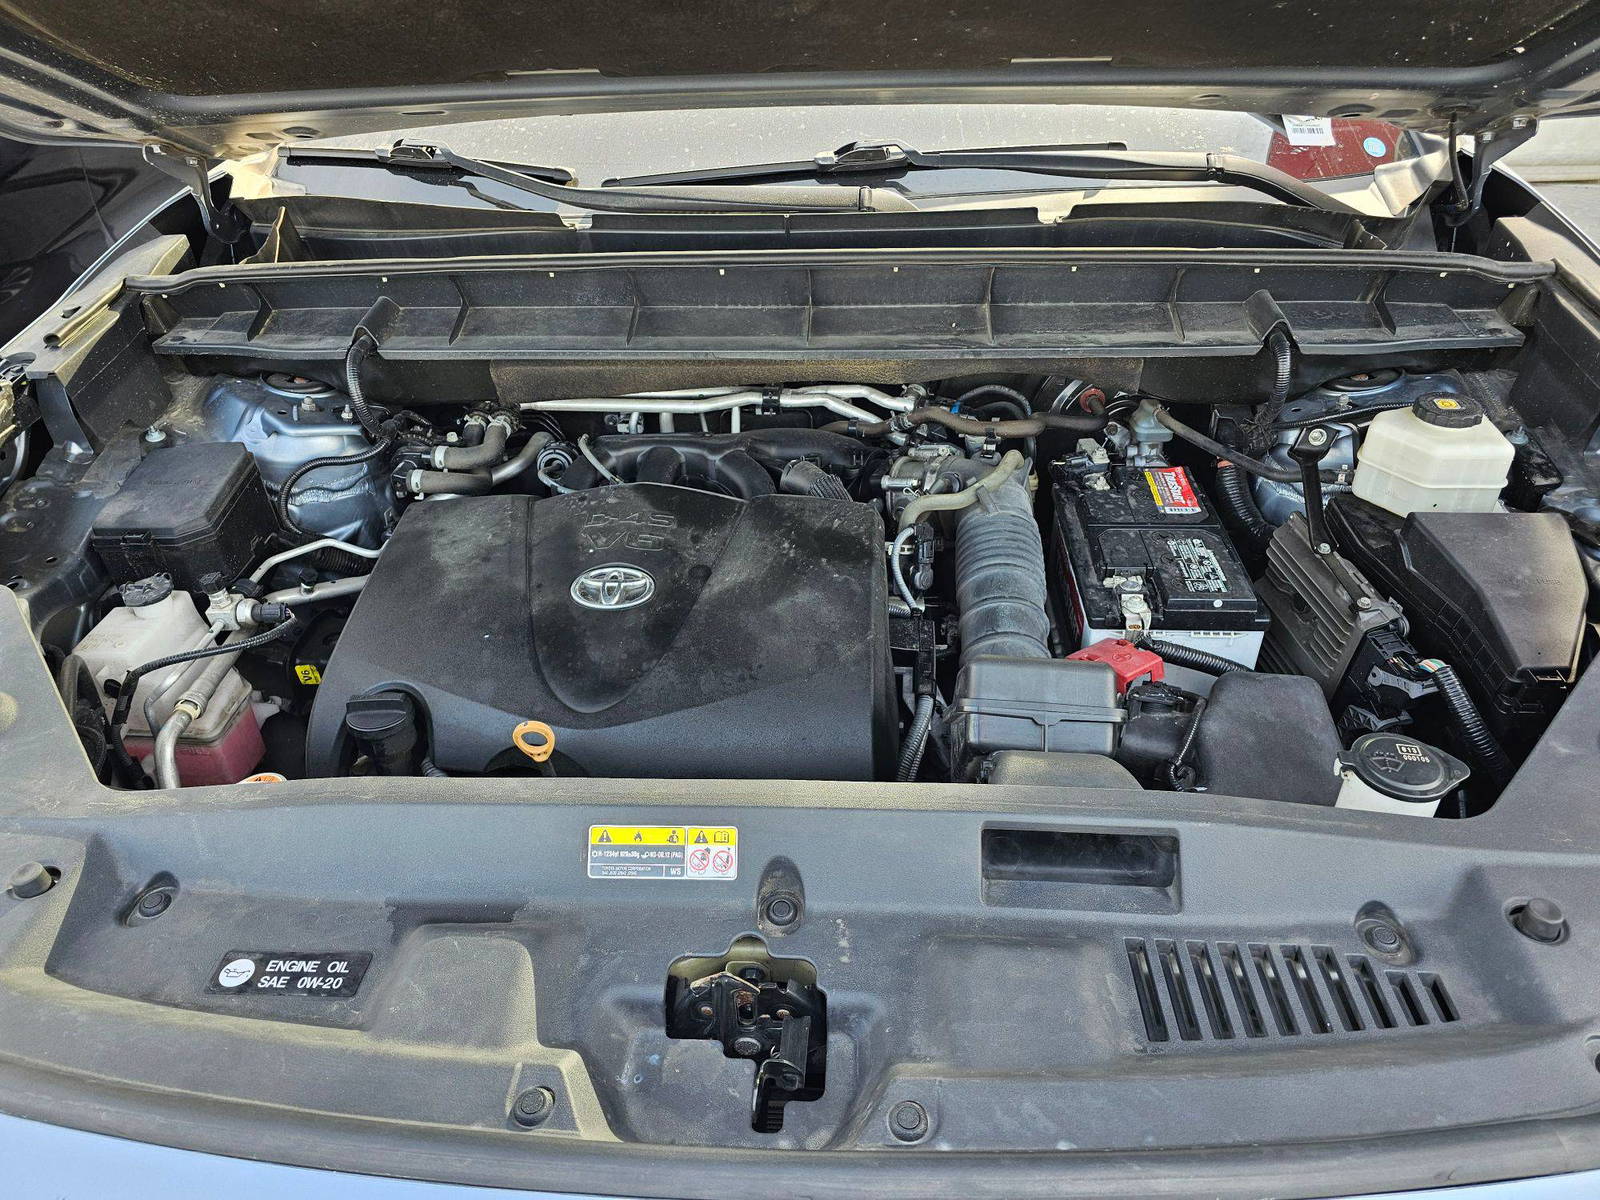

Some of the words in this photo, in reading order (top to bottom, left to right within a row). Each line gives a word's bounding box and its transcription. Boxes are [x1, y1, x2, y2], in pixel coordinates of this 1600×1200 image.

[265, 960, 320, 973] ENGINE
[327, 961, 349, 973] OIL
[257, 976, 290, 988] SAE
[297, 977, 343, 989] 0W-20
